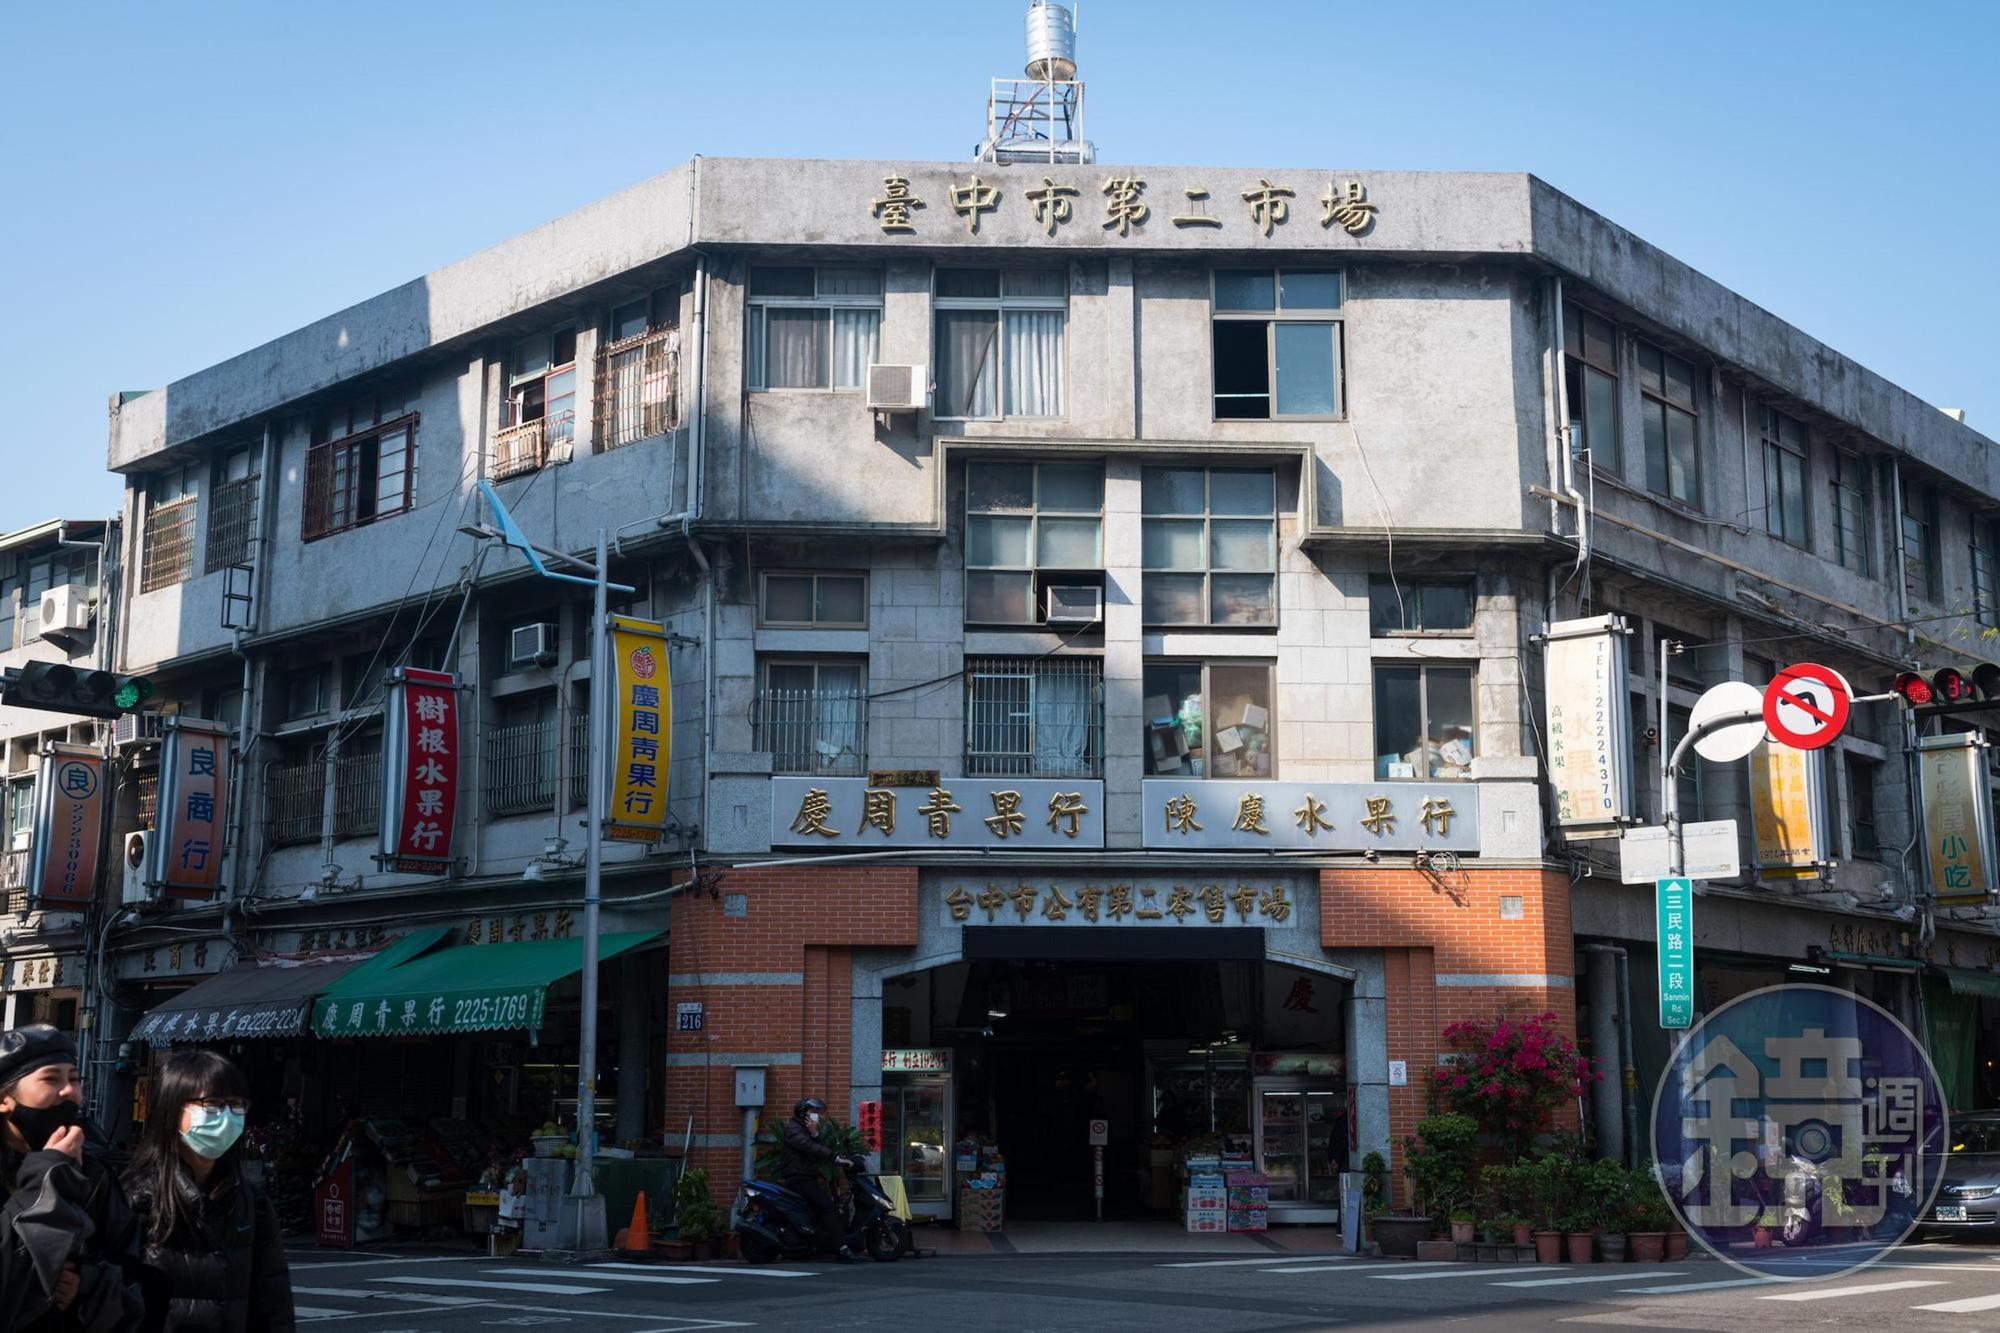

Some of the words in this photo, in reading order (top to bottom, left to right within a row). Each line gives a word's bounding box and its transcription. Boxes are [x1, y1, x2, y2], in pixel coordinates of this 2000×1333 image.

[872, 174, 1380, 237] 臺中市第二市場
[410, 694, 449, 850] 樹根水果行
[625, 684, 660, 815] 慶周青果行
[66, 768, 90, 793] 良
[182, 746, 217, 871] 良商行
[789, 787, 1089, 838] 慶周青果行
[1163, 795, 1457, 837] 陳慶水果行
[945, 882, 1293, 923] 台中市公有第二零售市場
[1666, 895, 1684, 989] 三民路二段
[320, 996, 446, 1030] 慶周青果行
[454, 994, 528, 1025] 2225-1769
[1663, 992, 1690, 1002] Sanmin
[682, 1013, 701, 1030] 216
